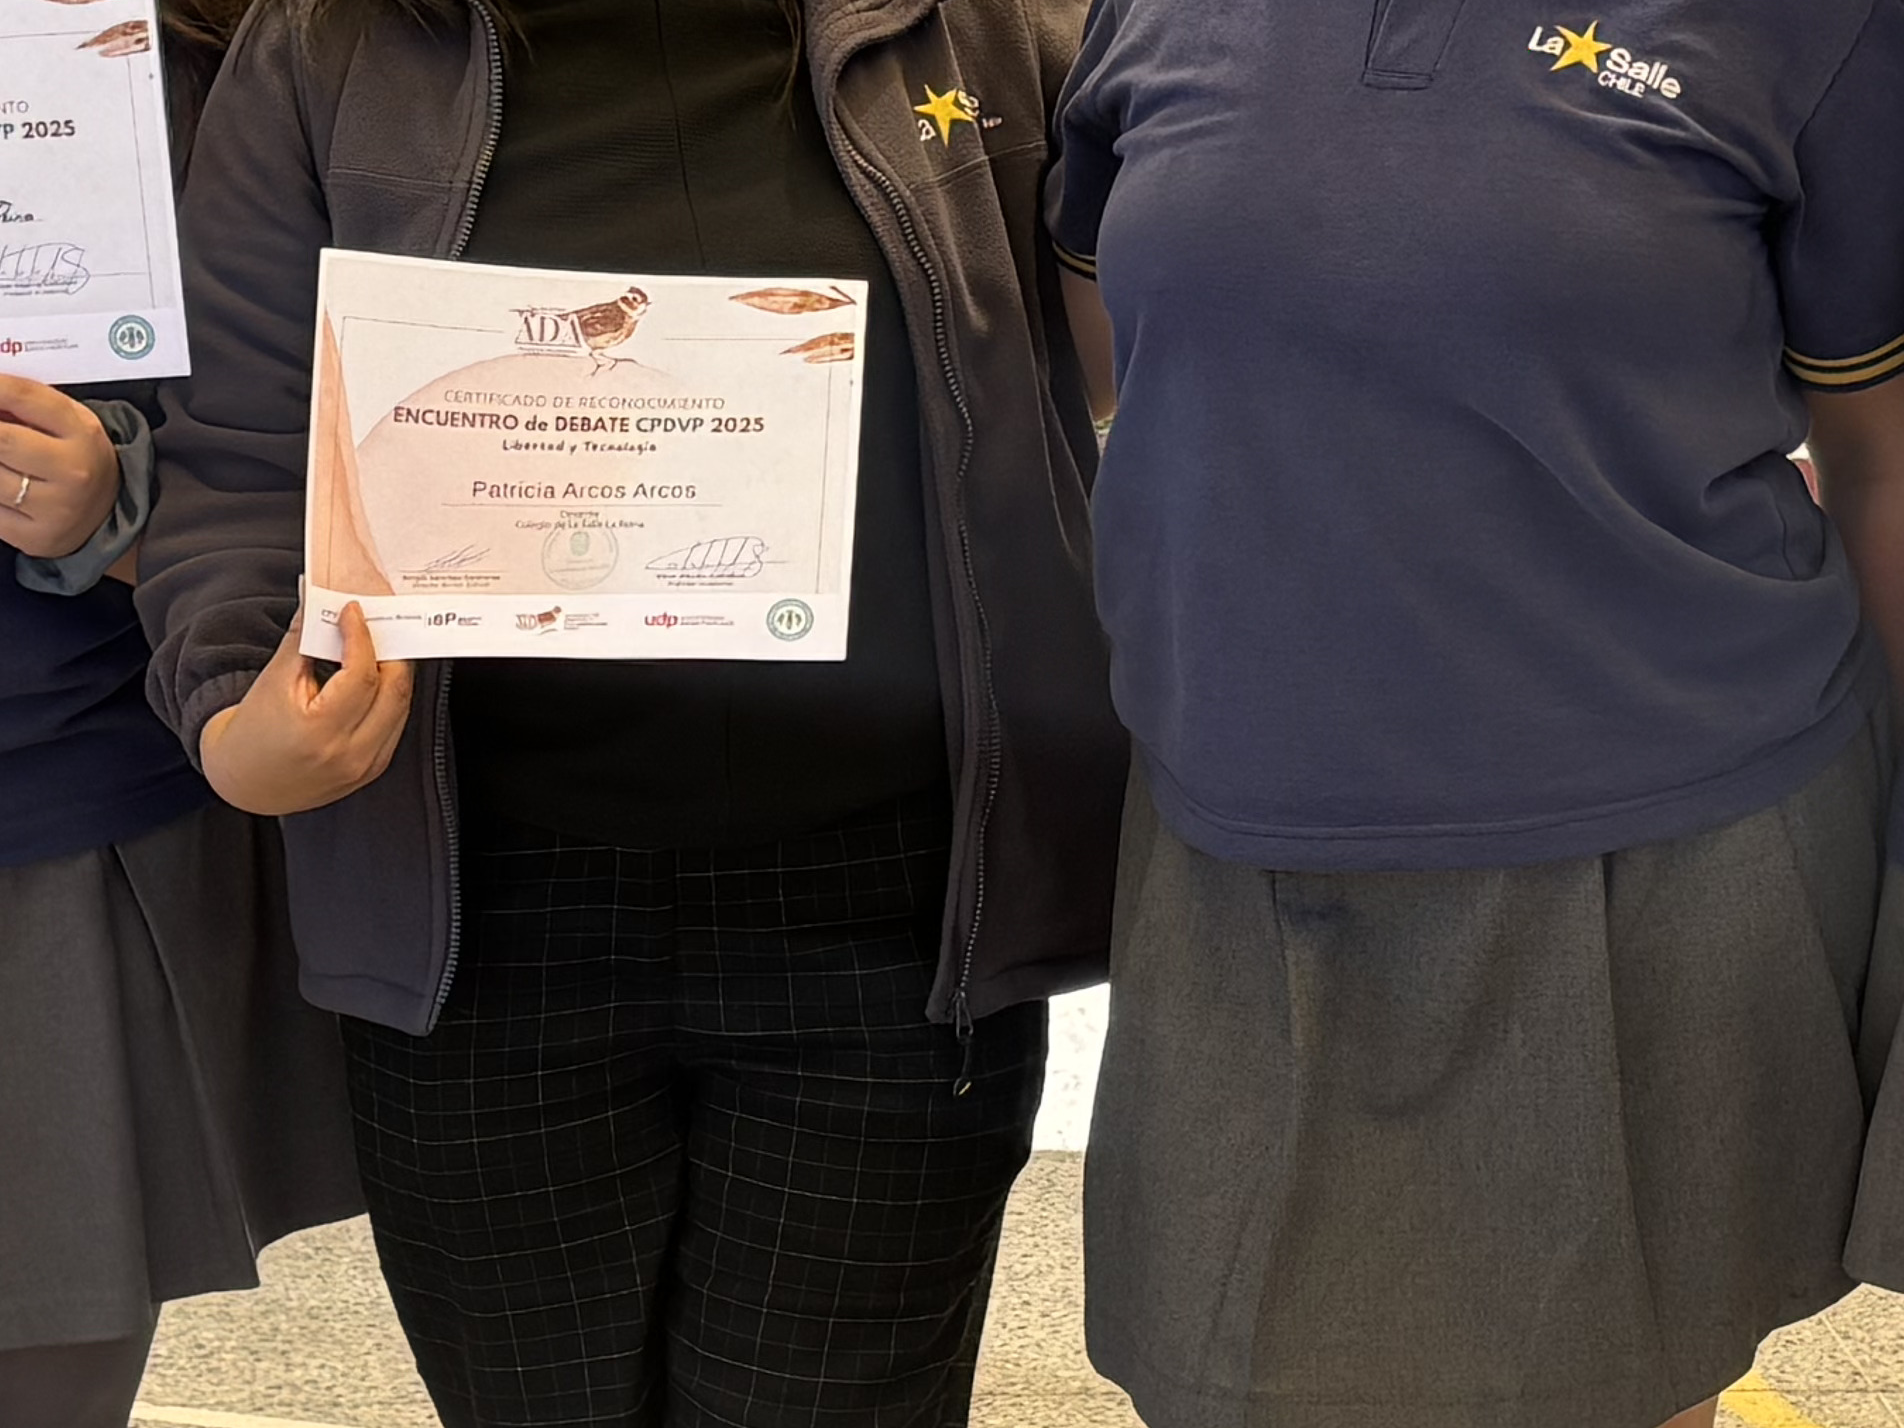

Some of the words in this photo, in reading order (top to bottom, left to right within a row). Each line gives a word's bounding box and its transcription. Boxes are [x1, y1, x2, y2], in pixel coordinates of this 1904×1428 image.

[1528, 26, 1565, 56] La
[1606, 47, 1681, 99] Salle
[1598, 70, 1645, 98] CHILE
[22, 120, 76, 140] 2025
[444, 390, 547, 408] CERTIFICADO
[553, 396, 575, 408] DE
[393, 406, 519, 430] ENCUENTRO
[525, 418, 549, 432] de
[555, 417, 630, 433] DEBATE
[635, 417, 705, 433] CPDVP
[711, 417, 765, 433] 2025
[472, 481, 555, 499] Patricia
[562, 482, 626, 499] Arcos
[632, 482, 696, 499] Arcos
[644, 612, 678, 628] udp
